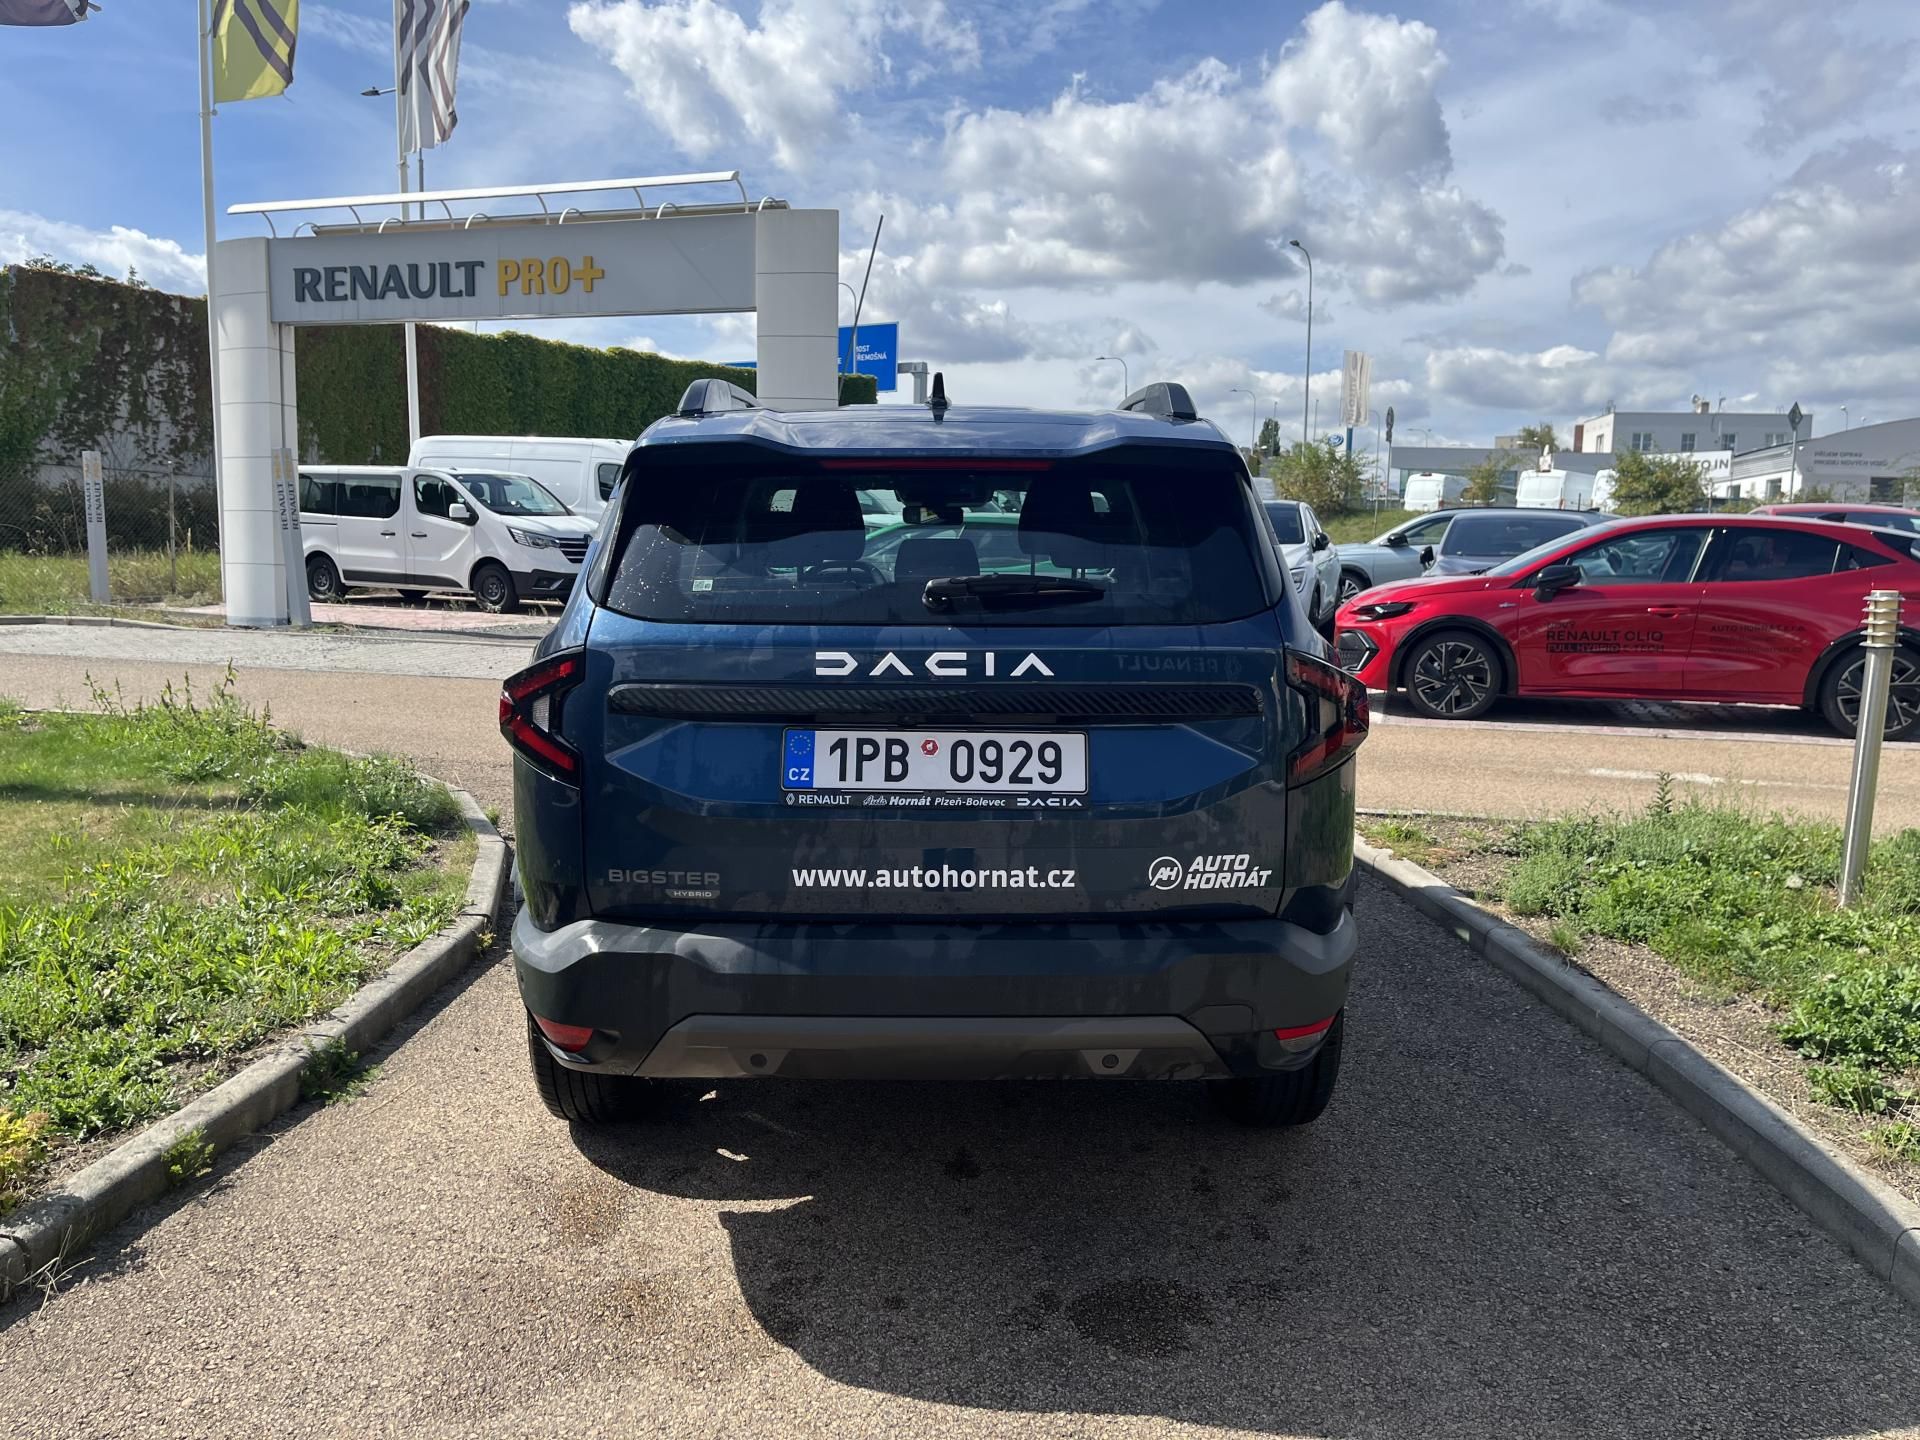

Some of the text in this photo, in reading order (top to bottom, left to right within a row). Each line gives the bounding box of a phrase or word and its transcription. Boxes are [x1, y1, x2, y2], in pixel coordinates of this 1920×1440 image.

[293, 255, 606, 302] RENAULT PRO+
[1714, 458, 1729, 469] IN
[94, 482, 103, 523] RENAULT
[276, 483, 289, 530] RENAULT
[287, 482, 299, 530] RENAULT
[1547, 630, 1619, 641] RENAULT
[815, 651, 1055, 676] DACIA
[829, 737, 1062, 785] 1PB 0929
[788, 768, 810, 781] CZ
[798, 794, 852, 805] RENAULT
[889, 796, 931, 806] Hornát
[934, 797, 1006, 807] Plzeň-Bolevec
[1016, 798, 1083, 807] DACIA
[1188, 853, 1250, 873] AUTO
[608, 869, 721, 886] BIGSTER
[792, 864, 1076, 888] www.autohornat.cz
[1183, 866, 1273, 890] HORNÁT
[673, 890, 713, 898] HYBRID
